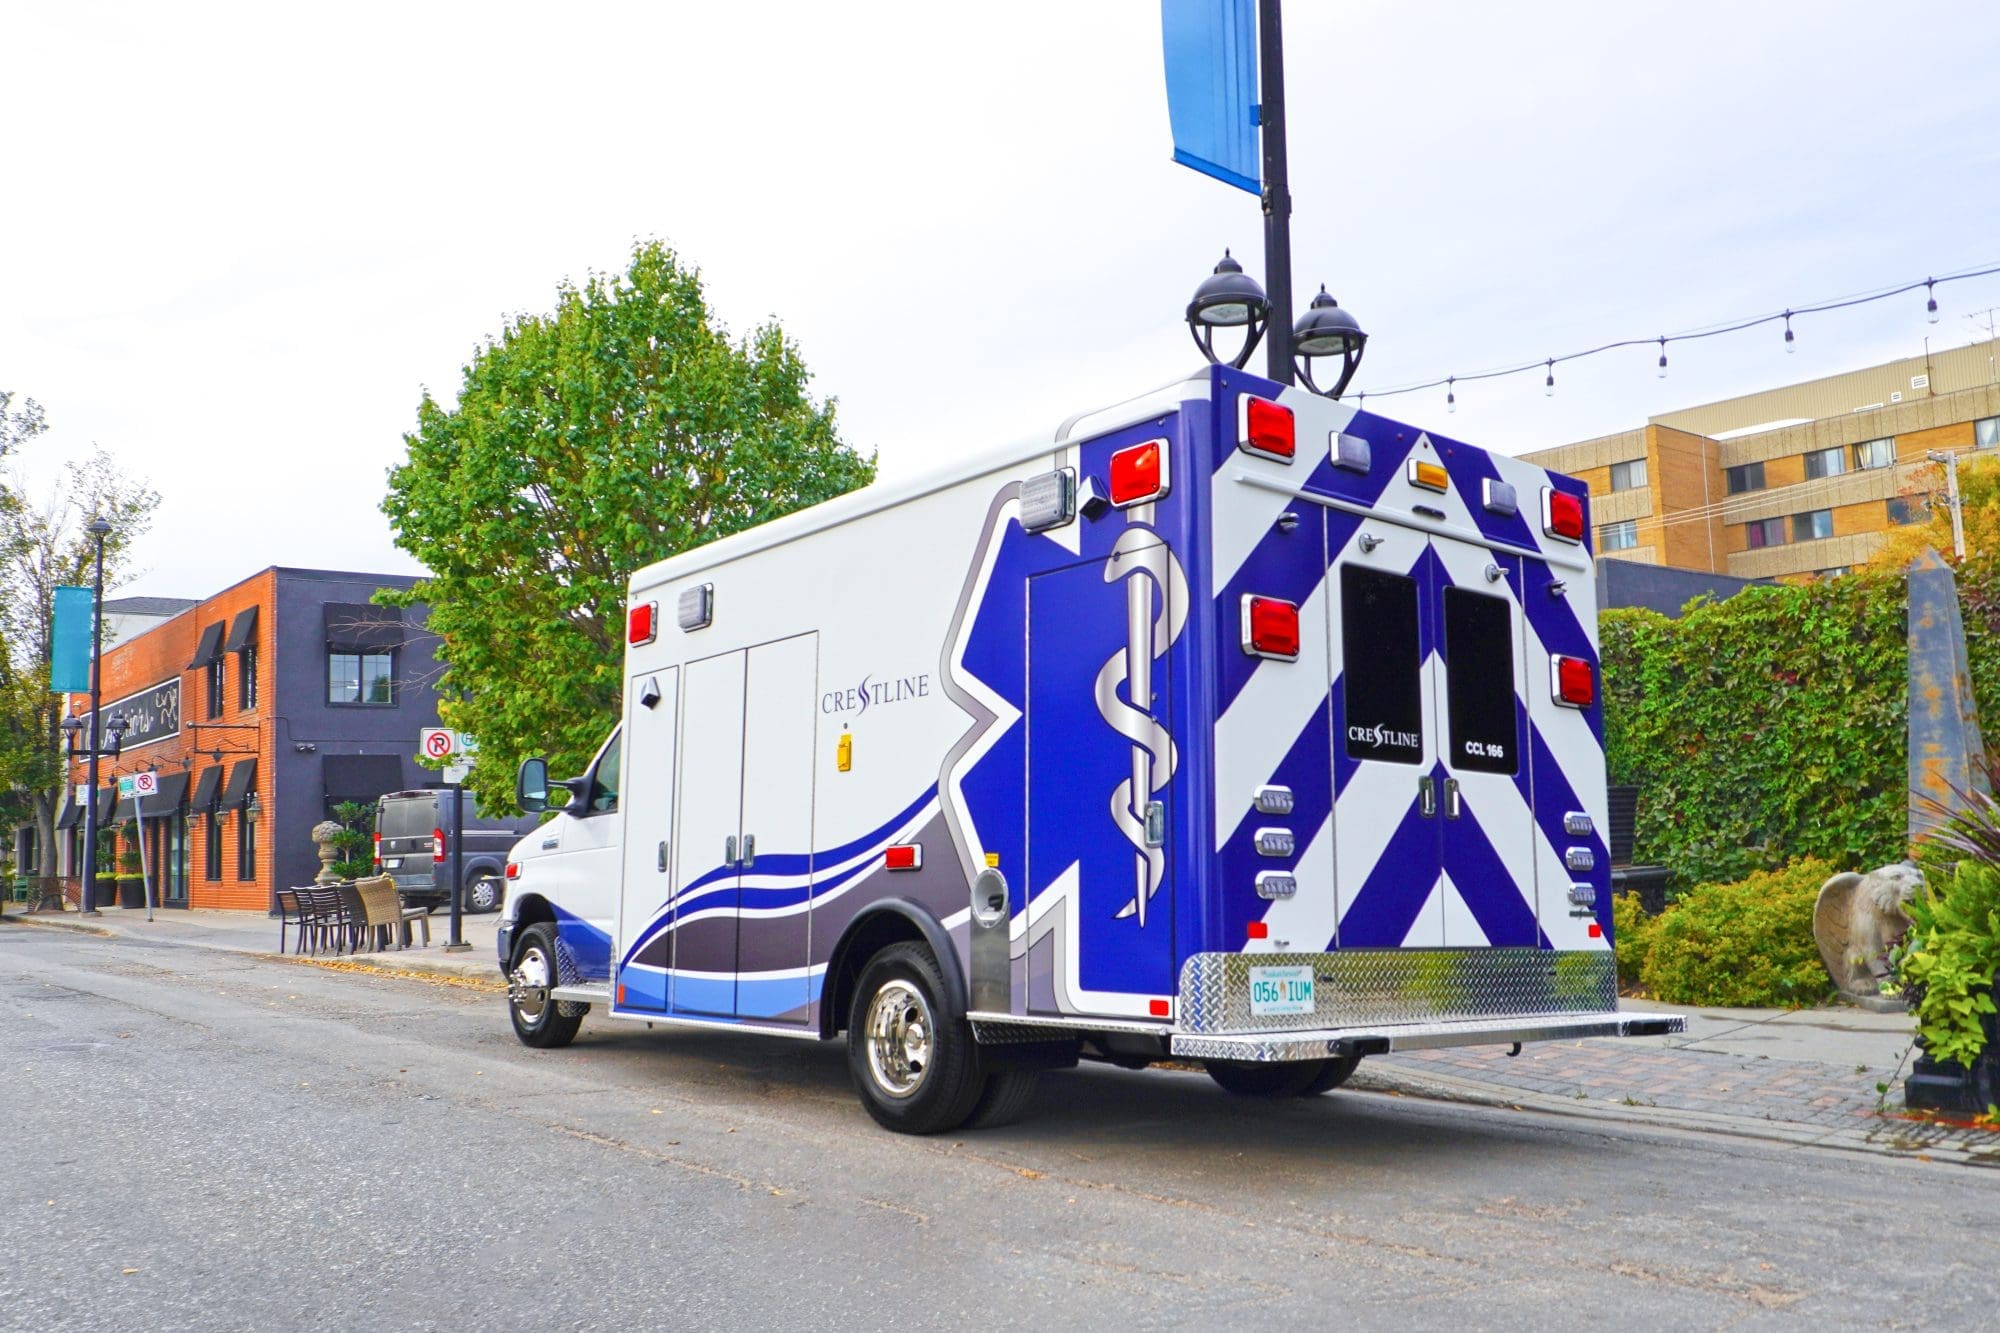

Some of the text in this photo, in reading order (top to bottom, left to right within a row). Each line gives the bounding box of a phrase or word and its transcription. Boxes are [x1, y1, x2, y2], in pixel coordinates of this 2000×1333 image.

[822, 674, 929, 716] CRESTLINE
[1348, 723, 1419, 748] CRESTLINE
[1465, 741, 1504, 758] CCL 166
[1253, 981, 1312, 1002] 056 IUM
